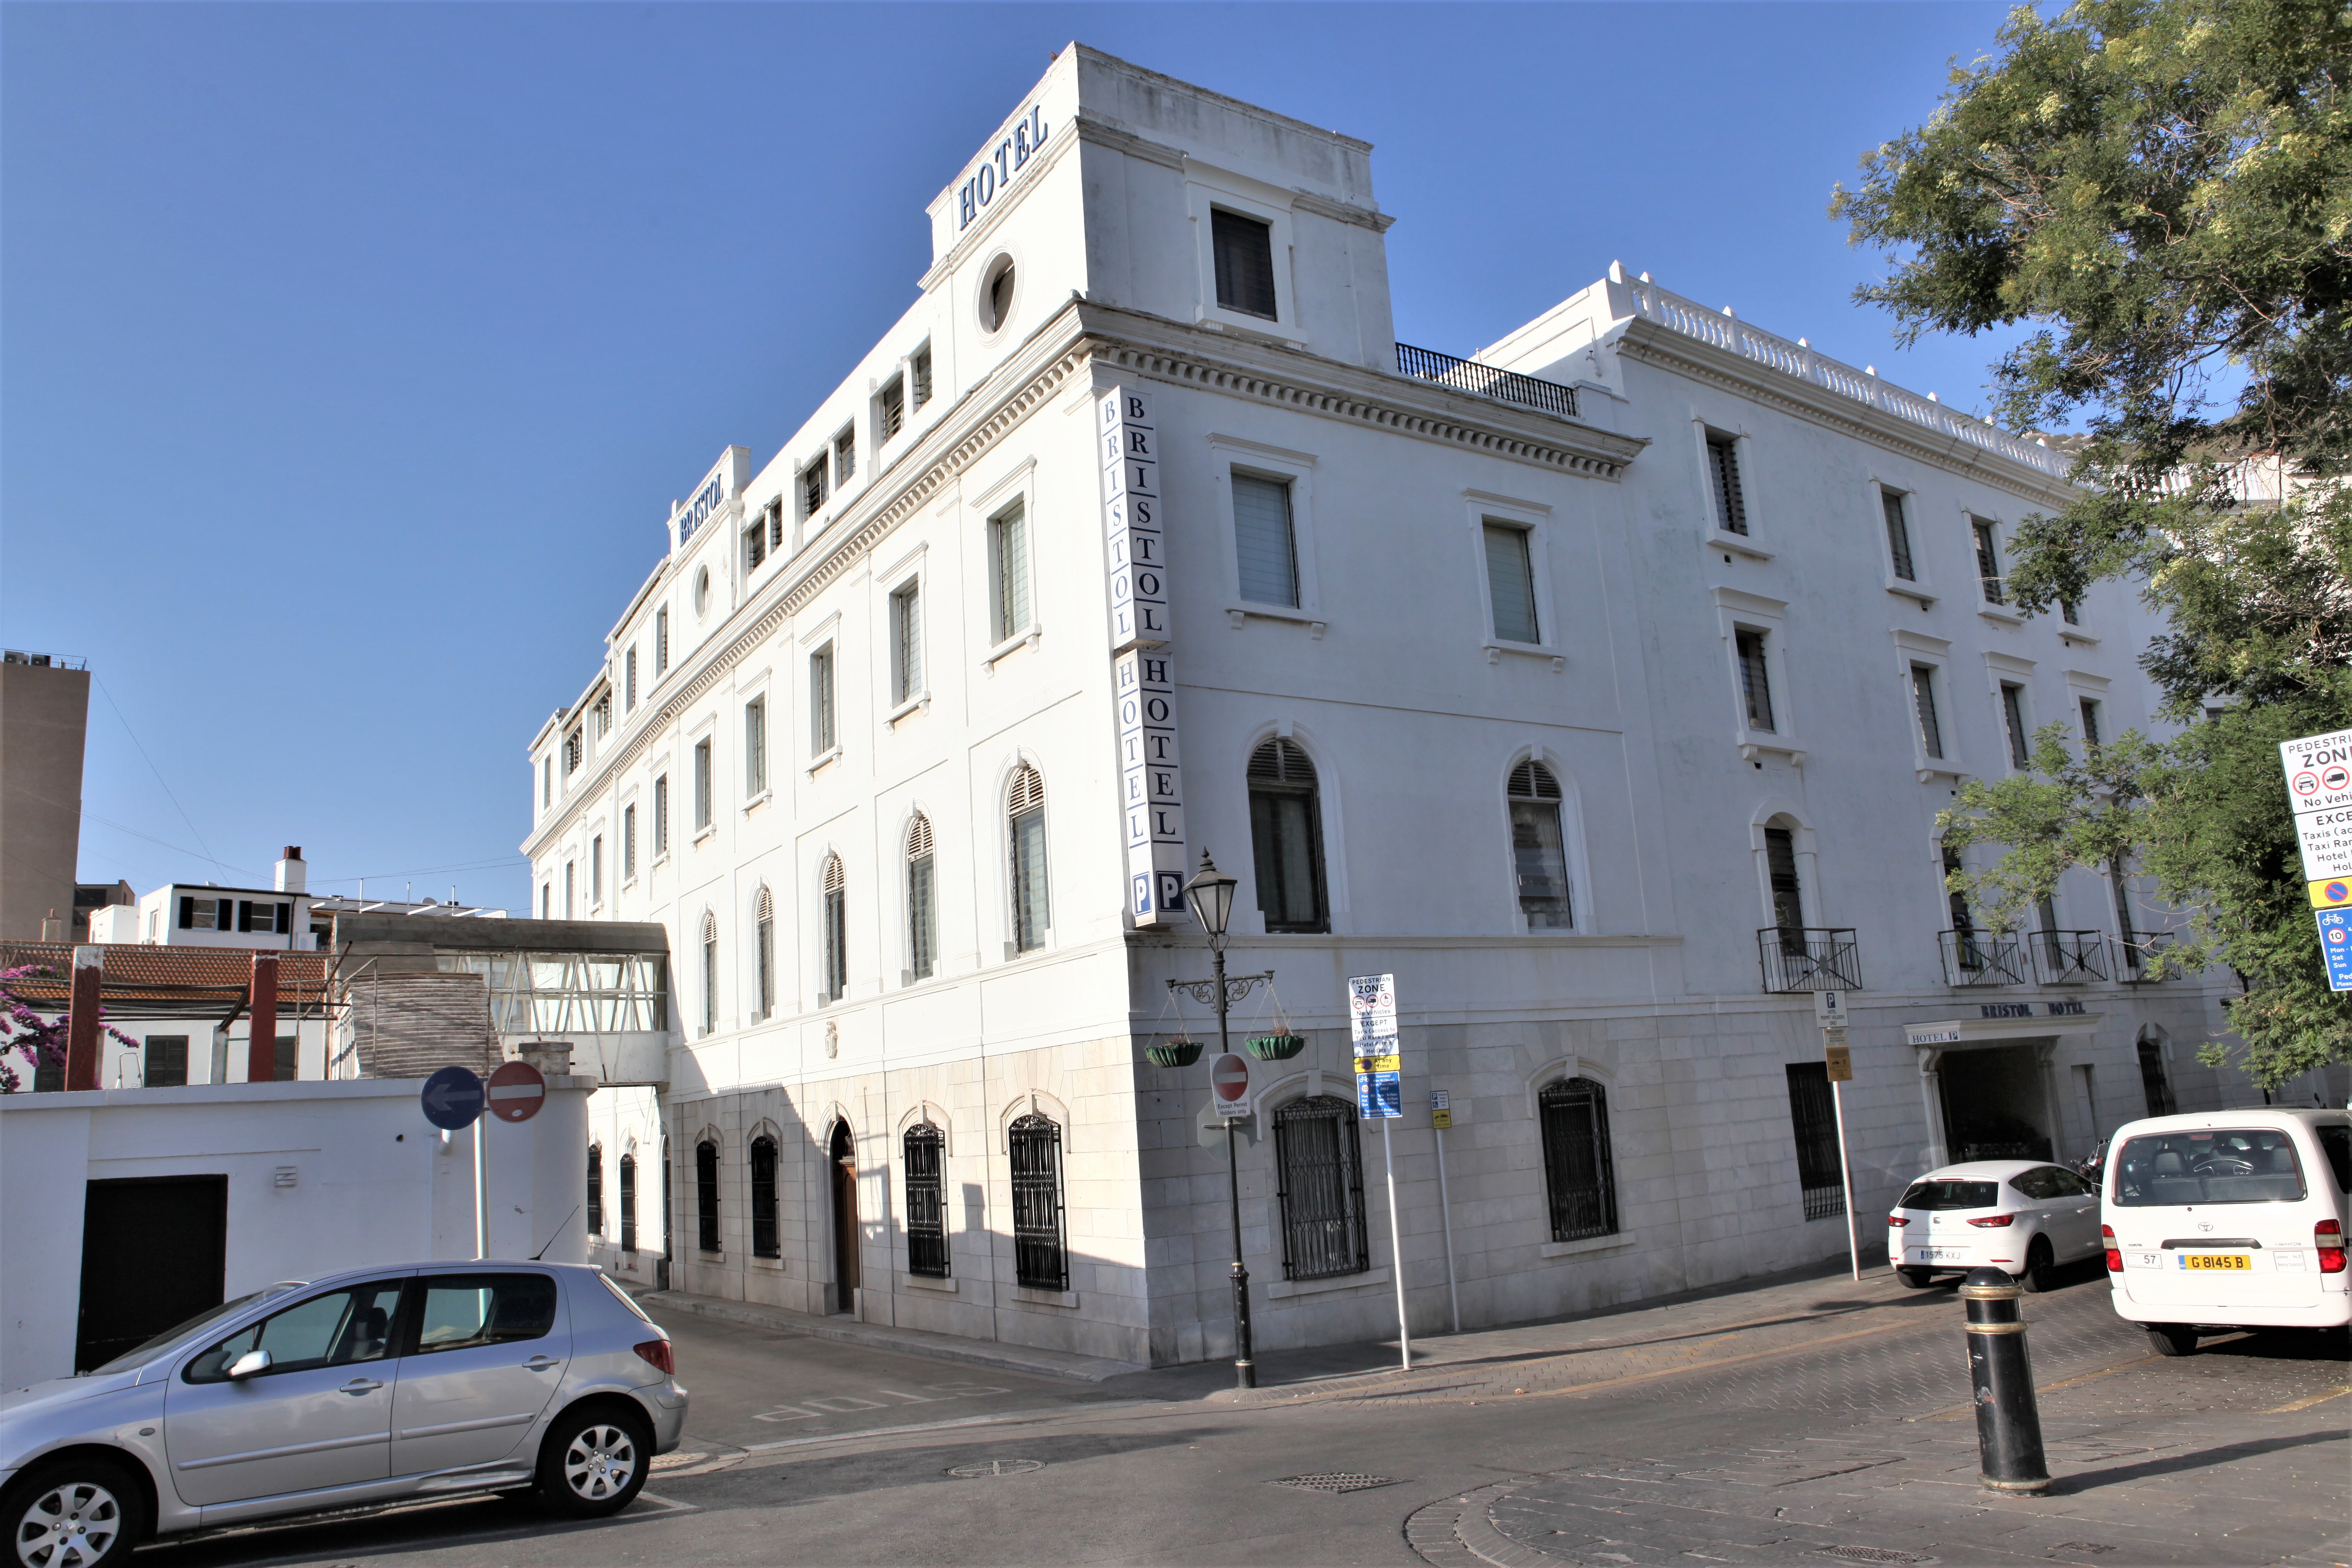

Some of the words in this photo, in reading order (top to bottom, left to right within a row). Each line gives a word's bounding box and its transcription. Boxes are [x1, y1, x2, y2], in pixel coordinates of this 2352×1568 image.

[958, 105, 1048, 231] HOTEL
[680, 473, 723, 547] BRISTOL
[1104, 400, 1130, 636] BRISTOL
[1127, 397, 1162, 632] BRISTOL
[1119, 660, 1143, 839] HOTEL
[1143, 658, 1176, 836] HOTEL
[2288, 734, 2352, 753] PEDESTRI
[2304, 798, 2321, 807] No
[2303, 830, 2331, 840] Taxis
[2307, 841, 2330, 851] Taxi
[2317, 851, 2347, 862] Hotel
[1135, 879, 1147, 912] P
[1164, 876, 1179, 907] P
[1358, 984, 1385, 993] ZONE
[1981, 1003, 2033, 1018] BRISTOL
[2048, 1001, 2086, 1015] HOTEL
[1913, 1033, 1947, 1044] HOTEL
[2144, 1255, 2156, 1264] 57
[2192, 1257, 2200, 1268] G
[2203, 1256, 2232, 1268] 8145
[2235, 1257, 2244, 1268] B
[752, 1382, 1013, 1422] STOP
